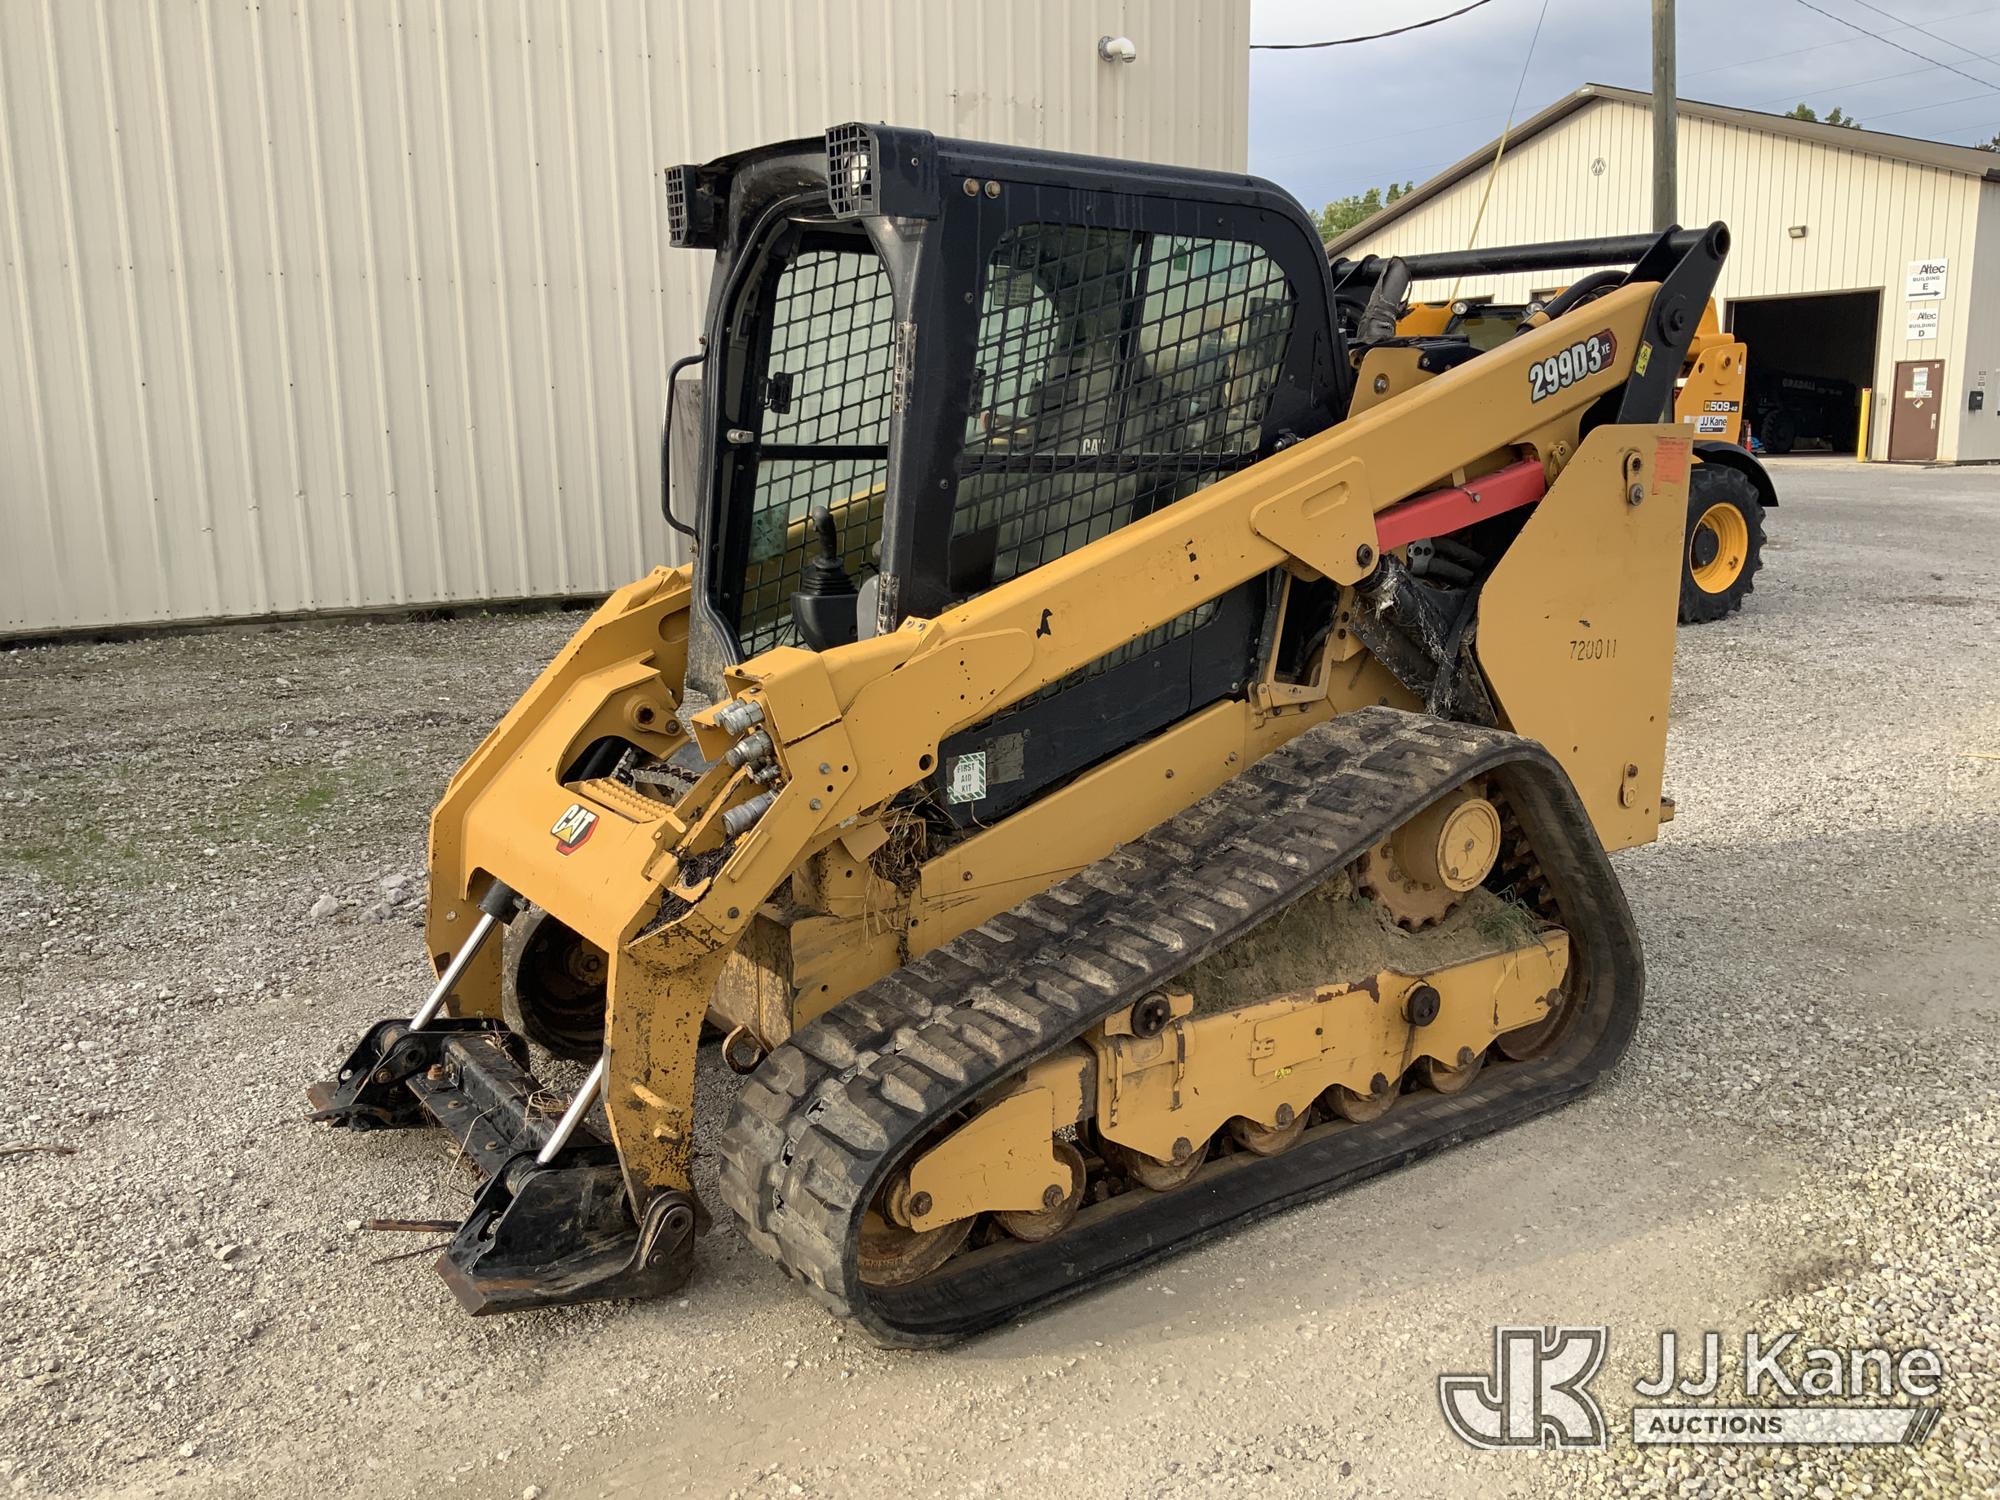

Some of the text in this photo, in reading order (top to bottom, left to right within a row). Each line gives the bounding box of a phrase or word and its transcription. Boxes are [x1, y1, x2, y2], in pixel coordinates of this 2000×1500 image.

[1920, 264, 1945, 275] Altec
[1917, 312, 1936, 320] Altec
[1529, 336, 1611, 402] 299D3 XE
[1701, 417, 1727, 426] JJ Kane
[1570, 638, 1617, 660] 720011
[957, 763, 975, 774] FIRST
[961, 774, 972, 783] AID
[961, 784, 972, 793] KIT
[551, 804, 597, 844] CAT
